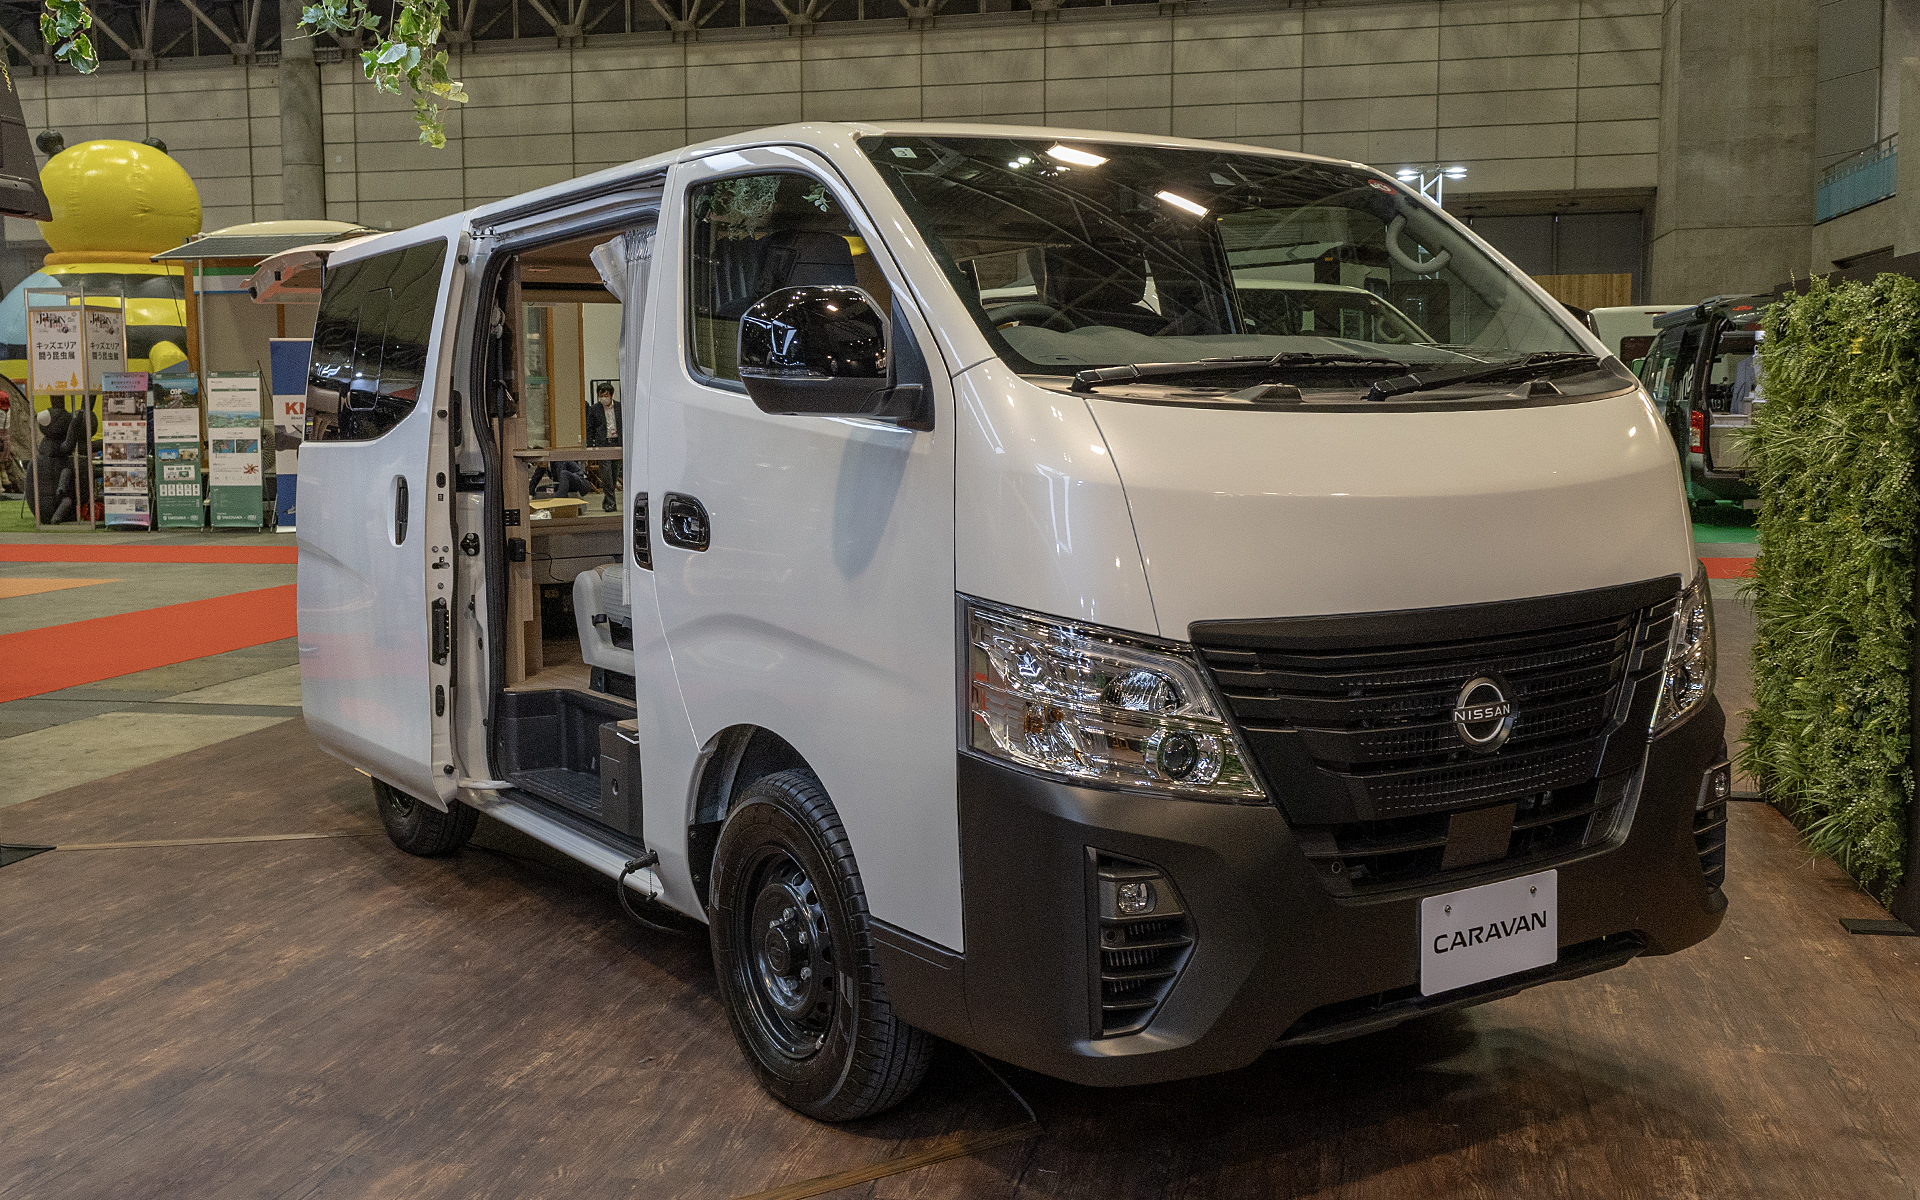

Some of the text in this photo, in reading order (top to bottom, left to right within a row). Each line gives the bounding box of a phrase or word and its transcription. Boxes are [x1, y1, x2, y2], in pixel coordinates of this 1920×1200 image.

[36, 341, 77, 350] キッズエリア
[90, 342, 120, 350] キッズエリア
[38, 351, 76, 360] 闘う昆虫展
[1454, 703, 1510, 721] NISSAN
[1433, 910, 1547, 954] CARAVAN
